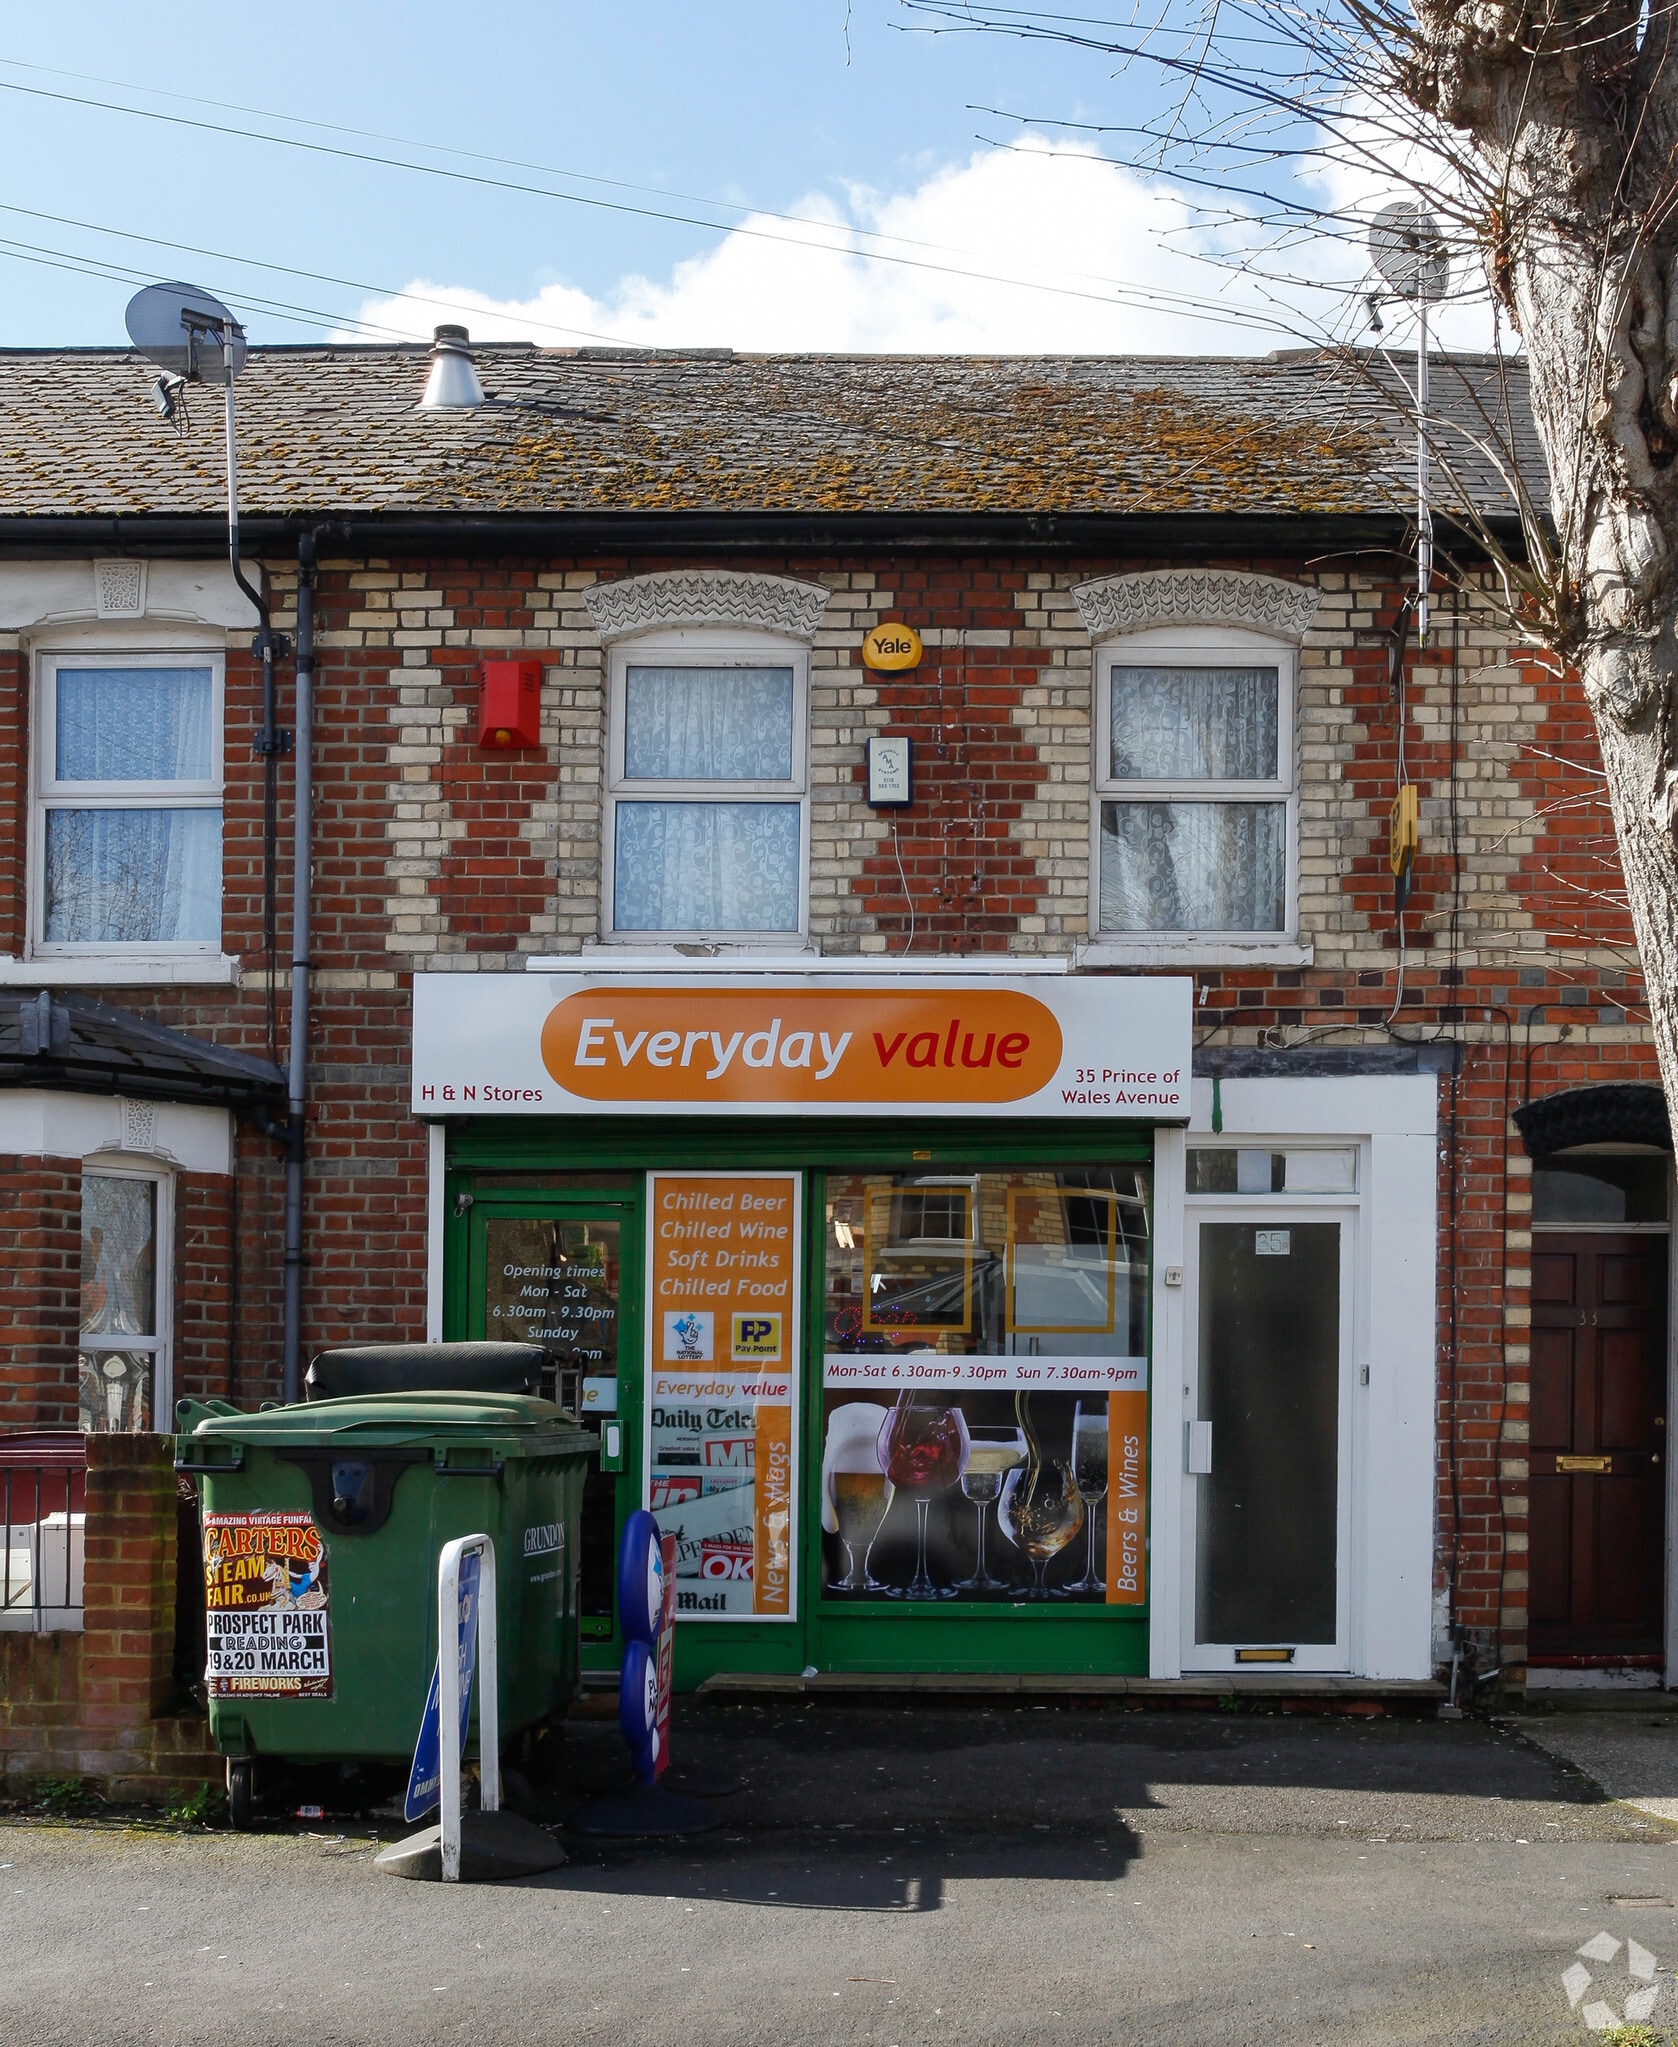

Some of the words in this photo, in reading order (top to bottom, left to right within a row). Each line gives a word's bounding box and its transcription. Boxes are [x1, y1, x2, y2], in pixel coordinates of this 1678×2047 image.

[873, 638, 912, 655] Yale
[574, 1018, 852, 1080] Everyday
[873, 1019, 1030, 1068] value
[1075, 1069, 1095, 1084] 35
[1101, 1068, 1157, 1084] Prince
[1162, 1068, 1180, 1084] of
[422, 1086, 433, 1101] H
[442, 1086, 457, 1101] &
[464, 1086, 477, 1101] N
[483, 1086, 543, 1101] Stores
[1061, 1089, 1111, 1105] Wales
[1116, 1090, 1180, 1105] Avenue
[663, 1192, 734, 1211] Chilled
[740, 1193, 786, 1211] Beer
[660, 1221, 731, 1239] Chilled
[739, 1222, 788, 1239] Wine
[667, 1250, 708, 1271] Soft
[715, 1250, 780, 1268] Drinks
[503, 1264, 561, 1279] Opening
[566, 1264, 605, 1277] times
[520, 1285, 549, 1298] Mon
[564, 1285, 588, 1298] Sat
[659, 1278, 730, 1296] Chilled
[736, 1279, 788, 1296] Food
[492, 1305, 546, 1318] 6.30am
[561, 1306, 615, 1322] 9.30pm
[1579, 1309, 1598, 1326] 33
[528, 1327, 579, 1341] Sunday
[736, 1345, 751, 1353] Pay
[828, 1364, 886, 1378] Mon-Sat
[891, 1364, 1007, 1380] 6.30am-9.30pm
[1016, 1366, 1042, 1379] Sun
[1046, 1366, 1138, 1381] 7.30am-9pm
[656, 1380, 735, 1398] Everyday
[742, 1380, 787, 1396] value
[651, 1408, 703, 1432] Daily
[764, 1441, 790, 1501] Mags
[1118, 1435, 1139, 1498] Wines
[763, 1512, 786, 1529] &
[1118, 1508, 1137, 1525] &
[205, 1526, 321, 1562] CARTERS
[524, 1522, 565, 1552] GRUNDON
[206, 1555, 265, 1586] STEAM
[1118, 1531, 1137, 1592] Beers
[762, 1540, 785, 1603] News
[676, 1592, 726, 1610] Mail
[209, 1614, 277, 1635] PROSPECT
[283, 1613, 323, 1634] PARK
[225, 1635, 303, 1650] READING
[261, 1651, 325, 1670] MARCH
[231, 1677, 302, 1690] FIREWORKS
